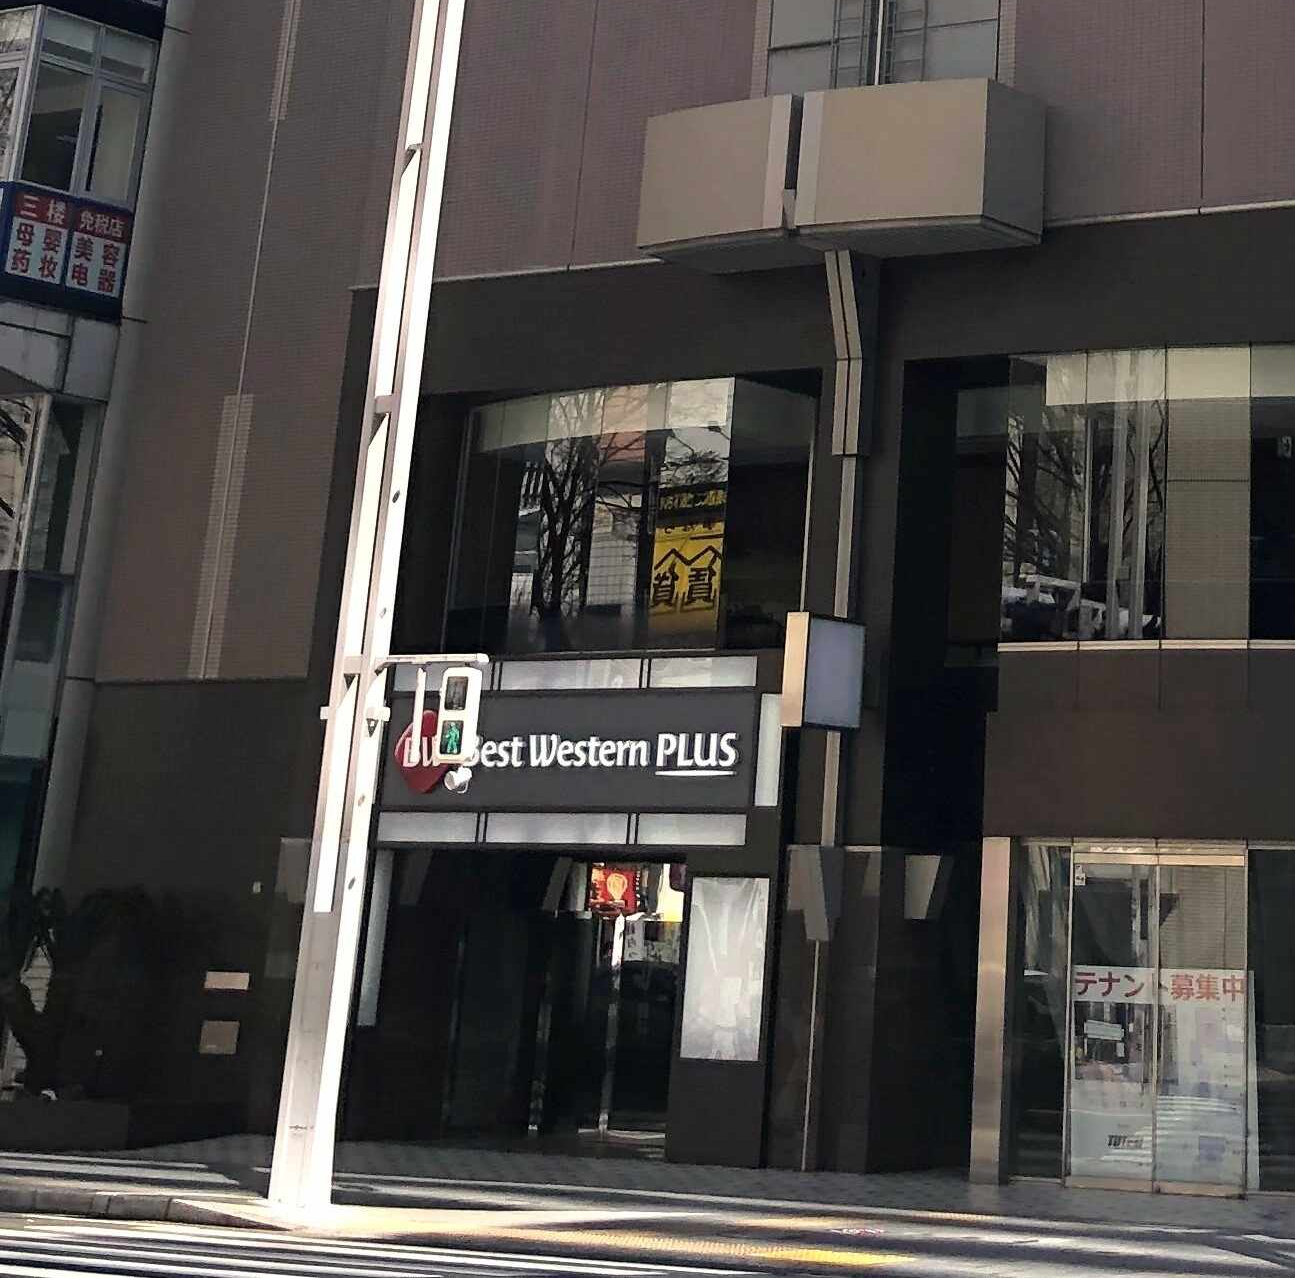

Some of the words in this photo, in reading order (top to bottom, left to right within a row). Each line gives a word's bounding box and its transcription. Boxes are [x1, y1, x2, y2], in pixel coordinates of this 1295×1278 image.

[528, 733, 649, 768] Western
[655, 732, 738, 768] PLUS
[1075, 972, 1246, 1002] テナント募集中
